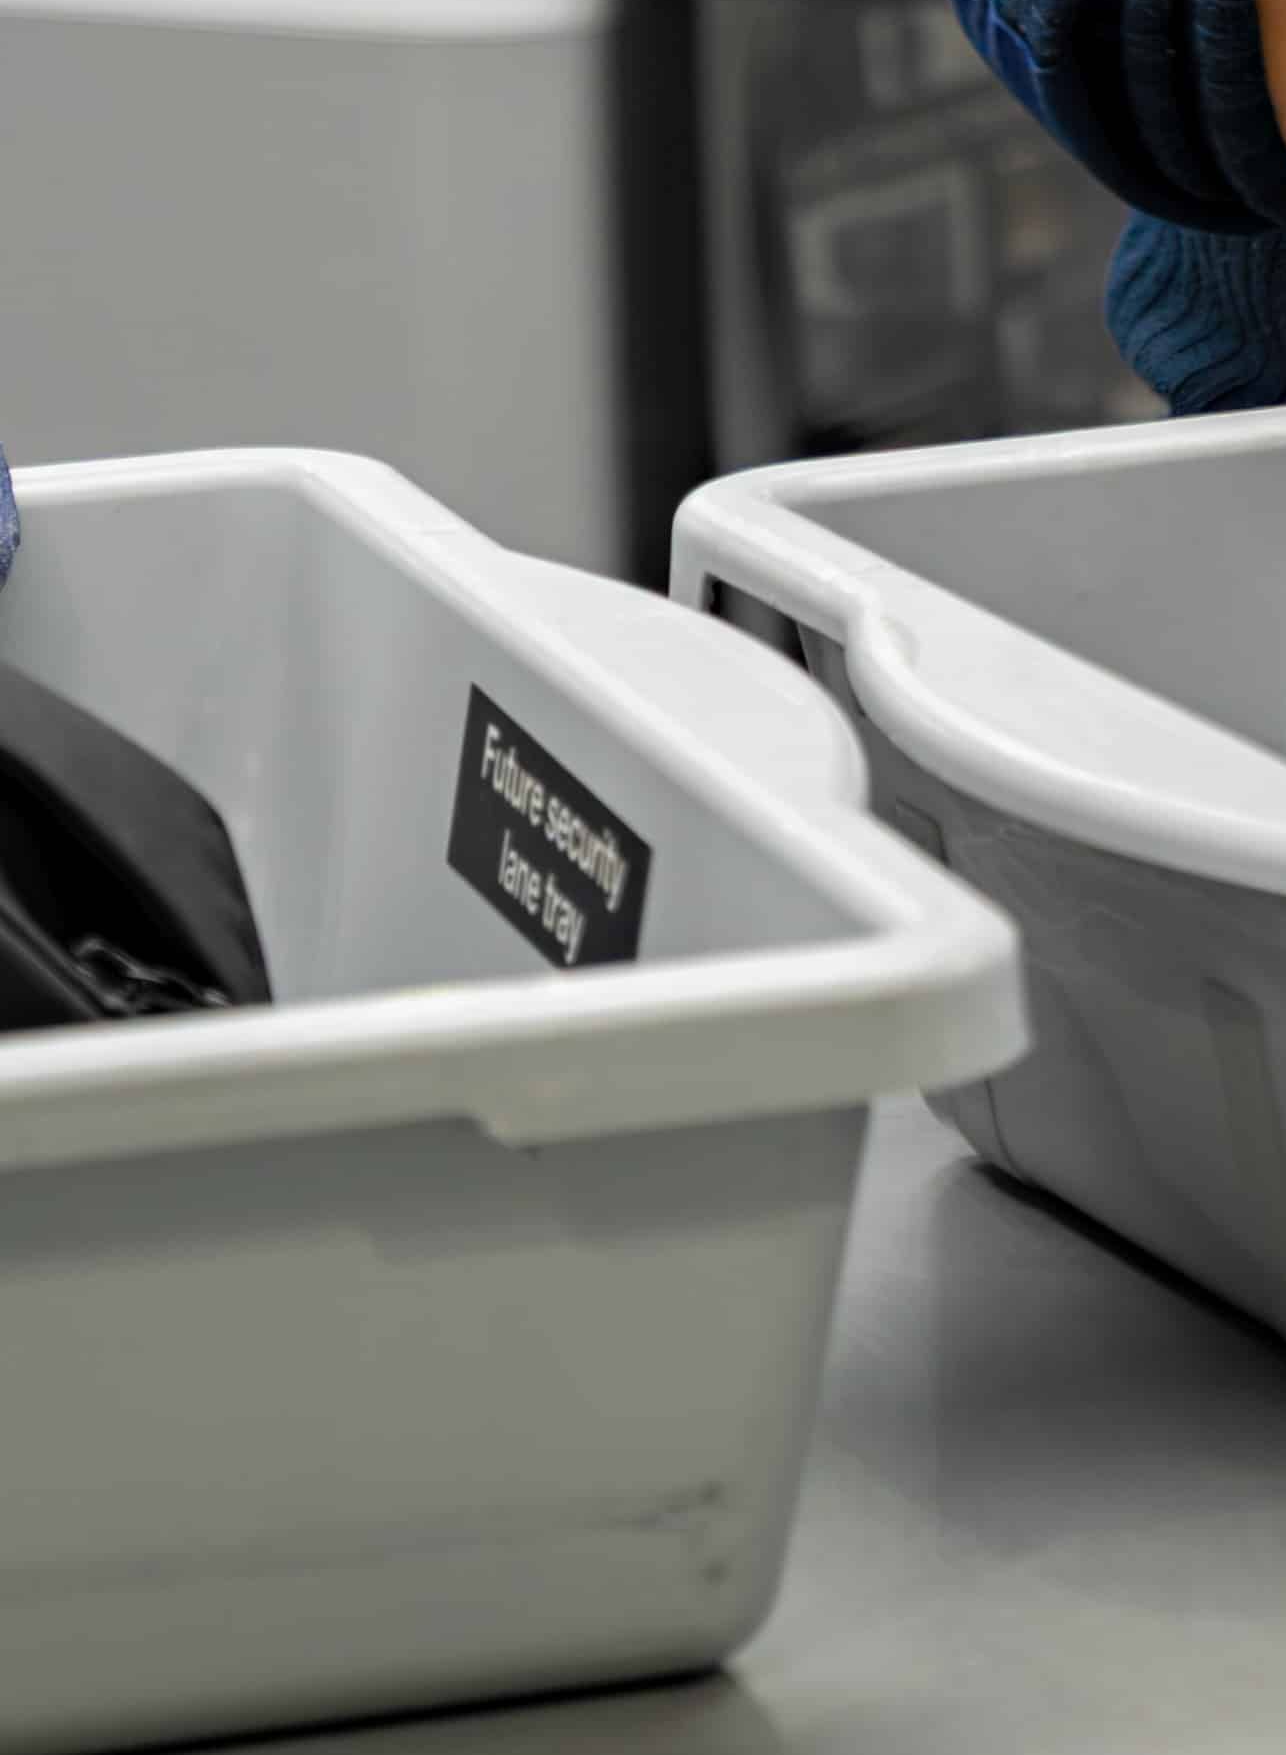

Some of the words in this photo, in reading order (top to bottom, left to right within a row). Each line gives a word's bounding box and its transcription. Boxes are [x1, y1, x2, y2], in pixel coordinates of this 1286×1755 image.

[480, 721, 545, 828] Future
[544, 794, 629, 914] security
[498, 827, 542, 917] lane
[541, 870, 586, 966] tray
